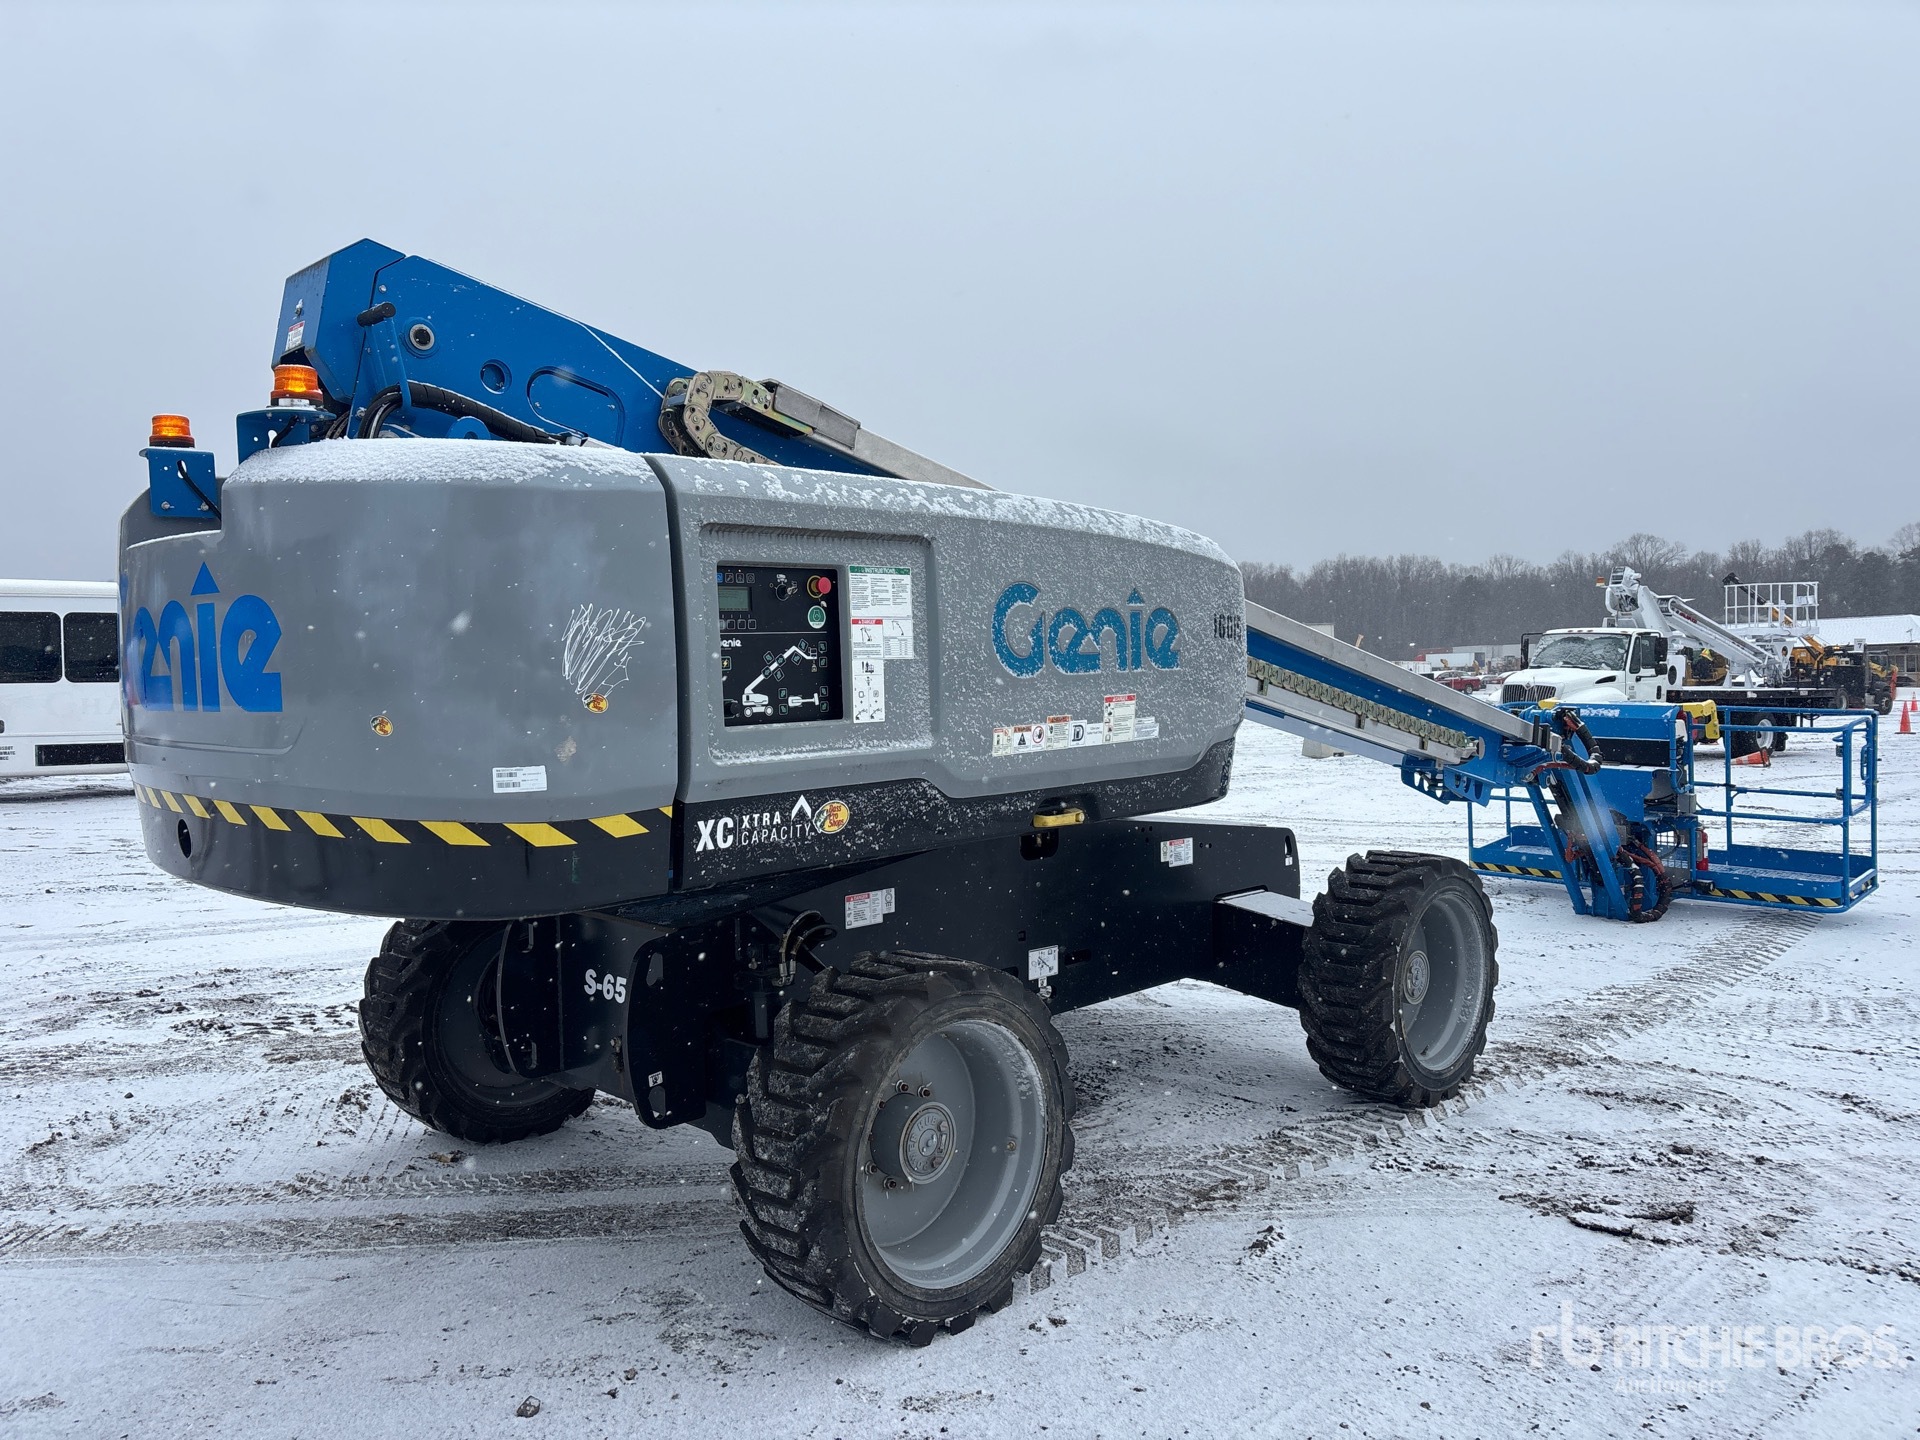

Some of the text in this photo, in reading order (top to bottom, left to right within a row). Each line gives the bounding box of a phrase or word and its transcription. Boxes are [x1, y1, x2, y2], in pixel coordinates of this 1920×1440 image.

[121, 561, 283, 713] enie
[992, 582, 1181, 679] Genie
[695, 816, 735, 853] XC
[741, 810, 782, 829] XTRA
[741, 822, 812, 846] CAPACITY
[584, 968, 627, 1004] S-65
